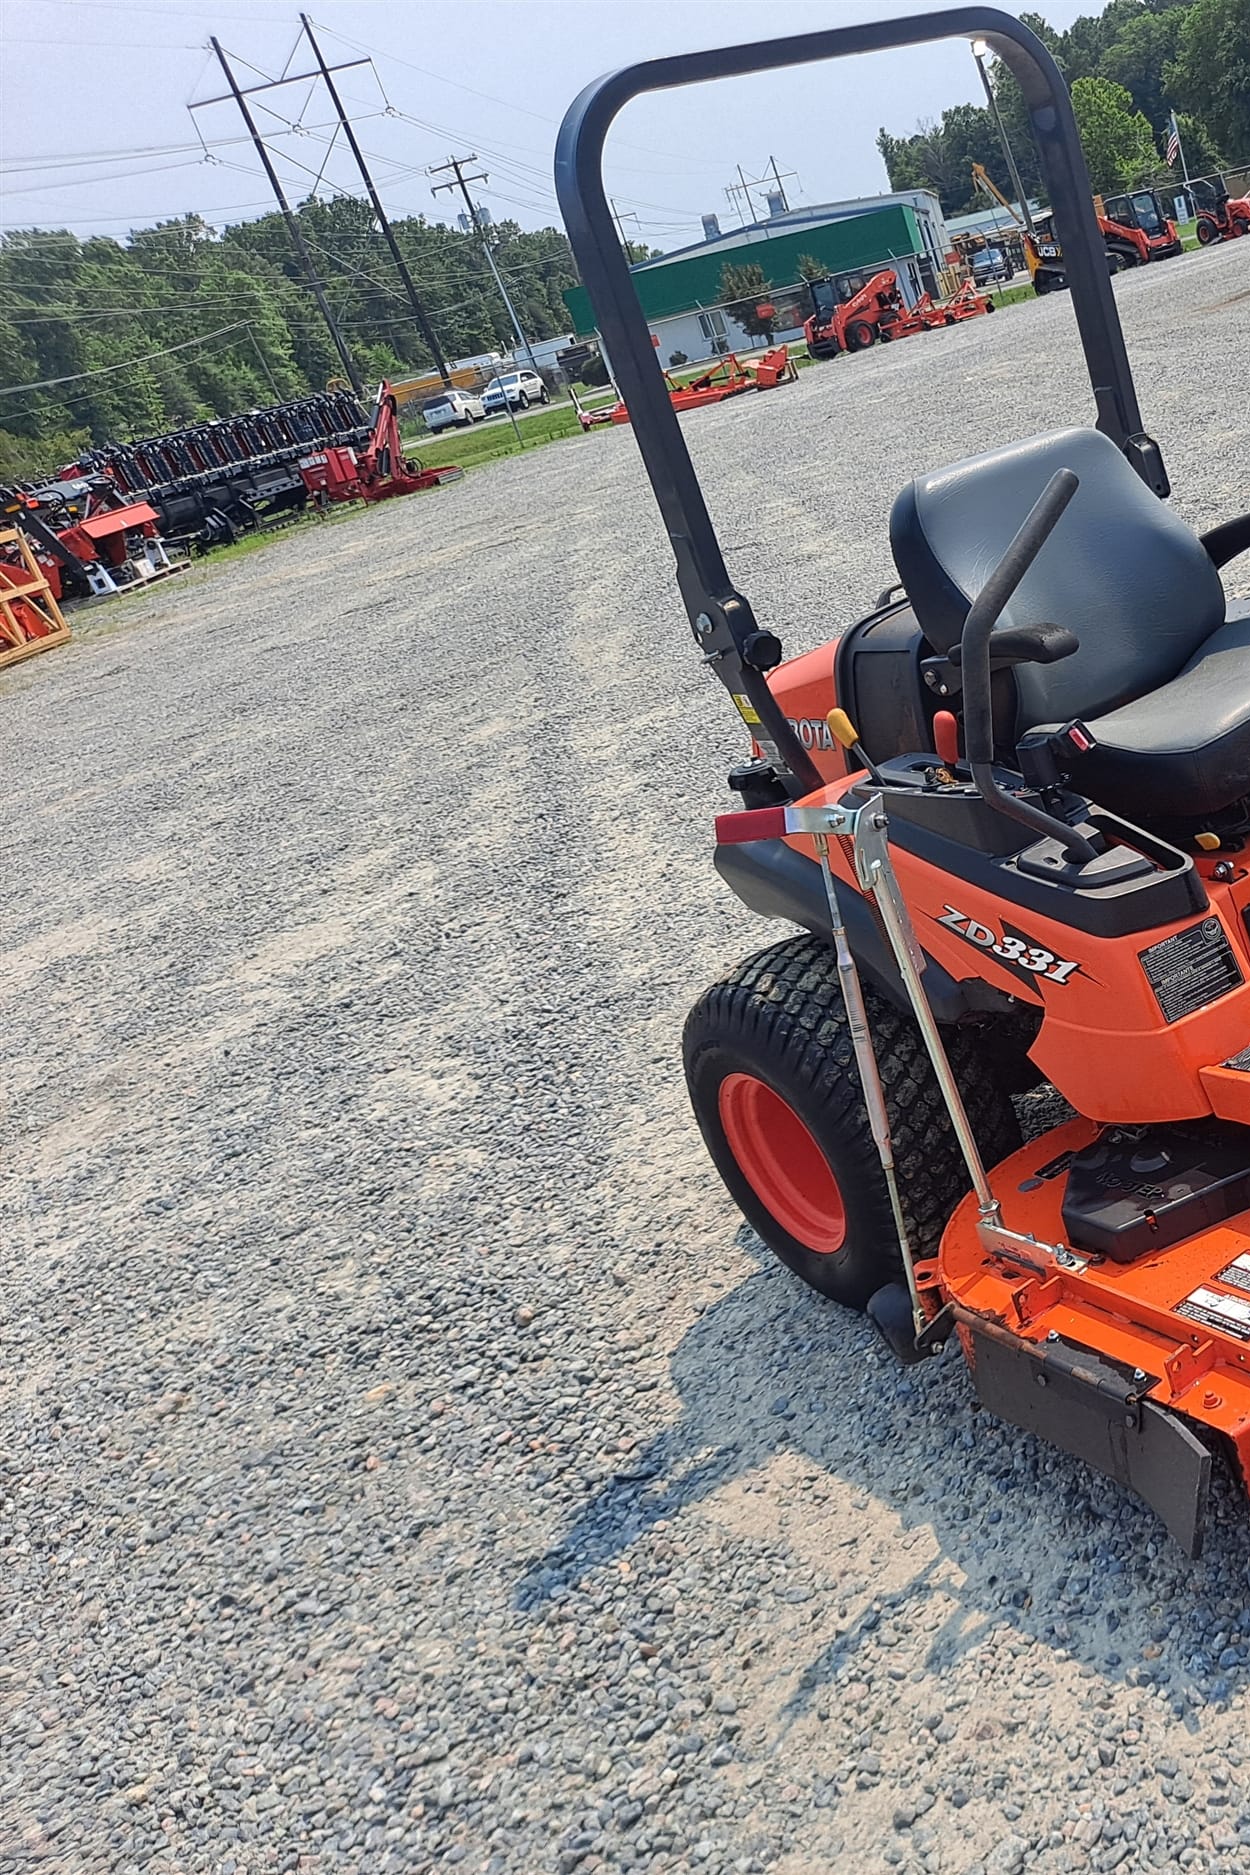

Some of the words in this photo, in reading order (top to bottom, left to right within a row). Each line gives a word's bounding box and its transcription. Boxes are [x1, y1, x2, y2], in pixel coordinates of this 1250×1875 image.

[785, 718, 836, 750] BOTA
[937, 903, 1080, 984] ZD331
[1148, 935, 1178, 953] IMPORTANT
[1160, 965, 1193, 985] IMPORTANTE
